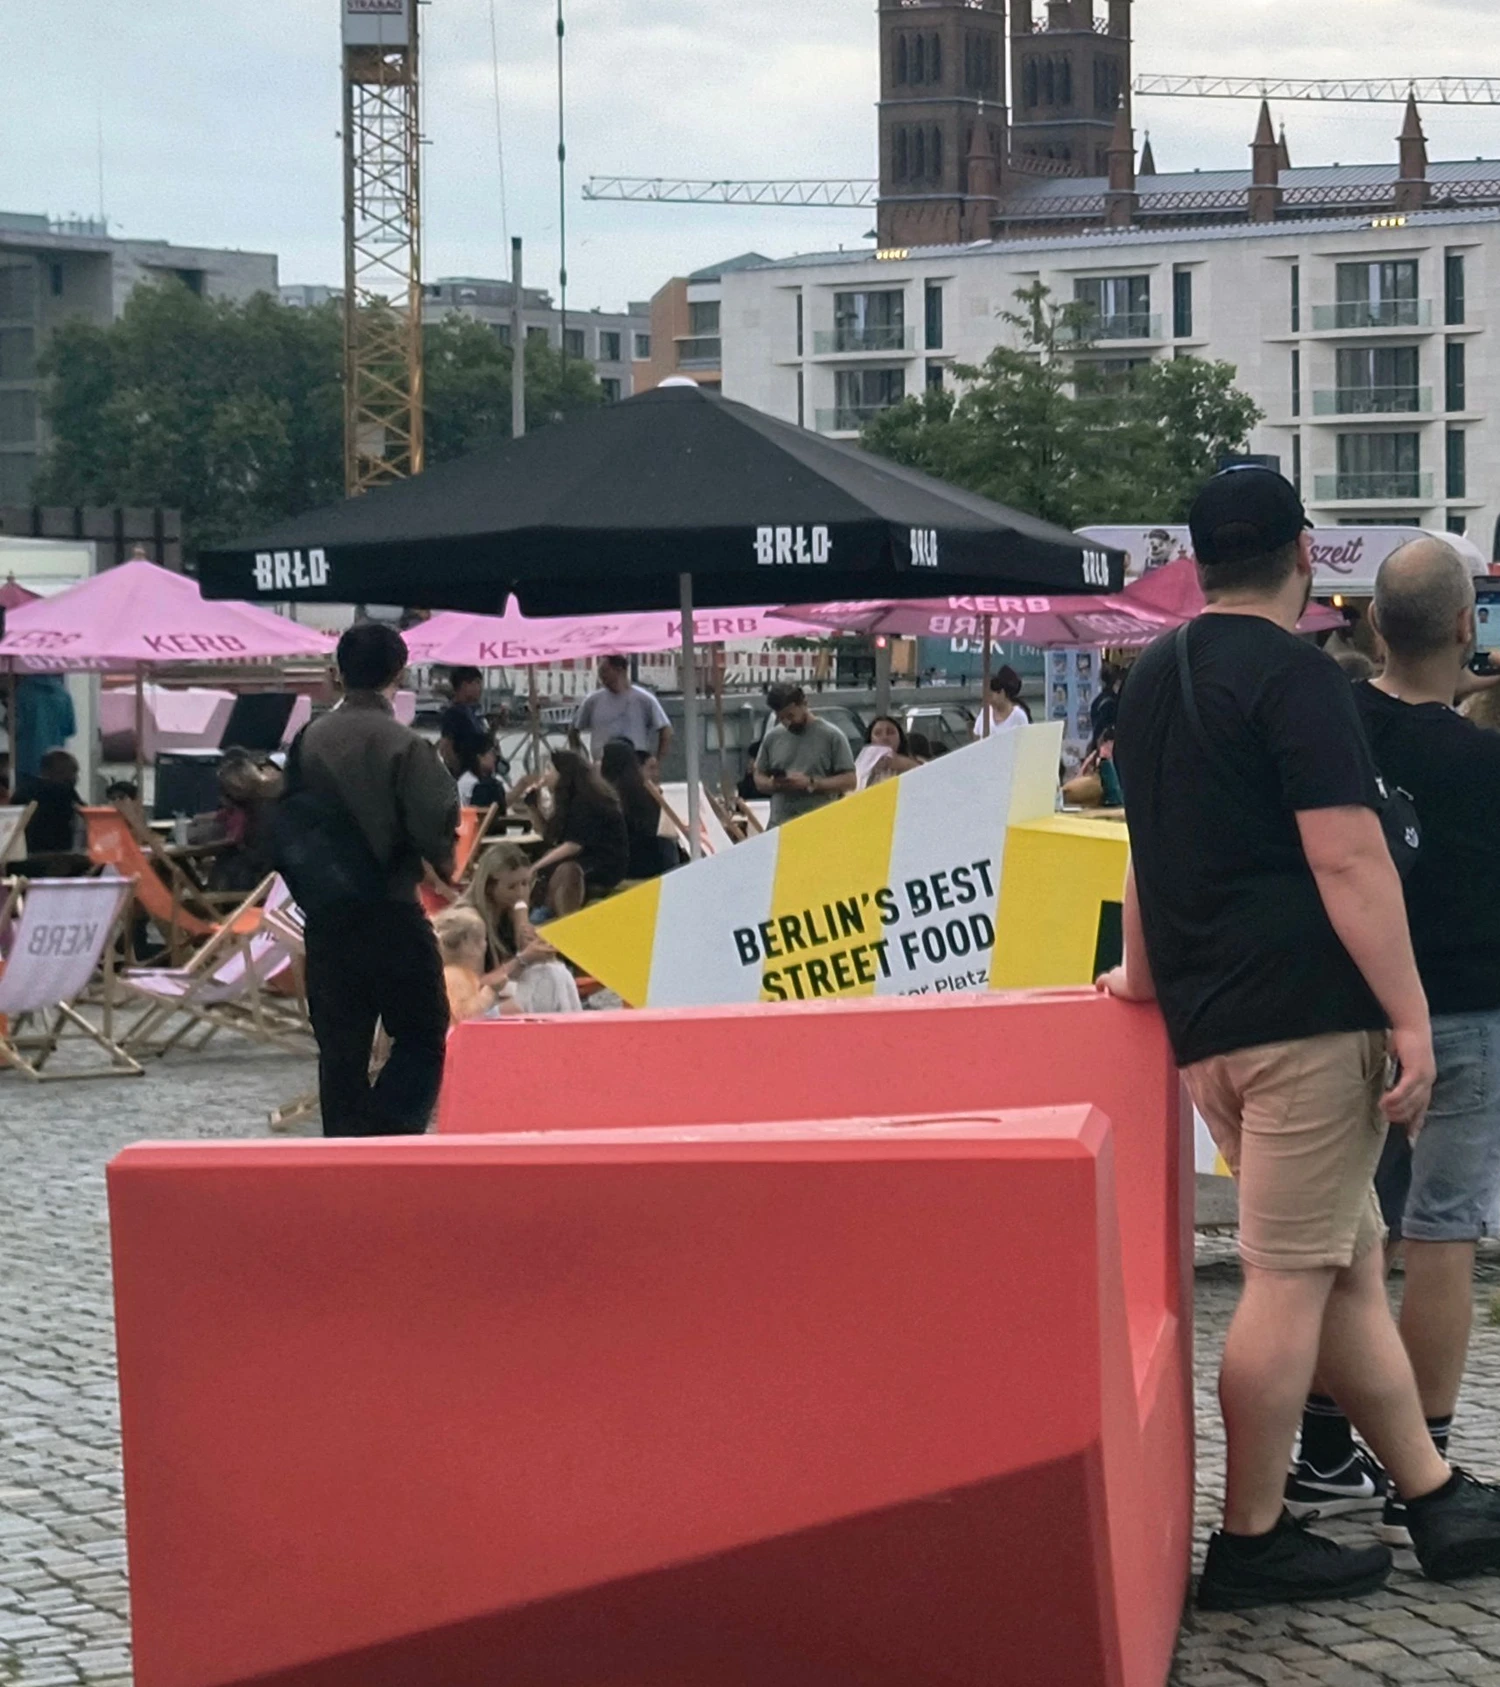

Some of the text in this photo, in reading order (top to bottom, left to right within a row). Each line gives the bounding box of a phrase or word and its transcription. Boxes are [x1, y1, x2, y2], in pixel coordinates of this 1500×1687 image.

[948, 596, 1051, 613] KERB
[142, 633, 247, 653] KERB
[732, 858, 995, 966] BERLIN'S BEST
[762, 912, 996, 1001] STREET FOOD
[934, 969, 989, 994] Platz
